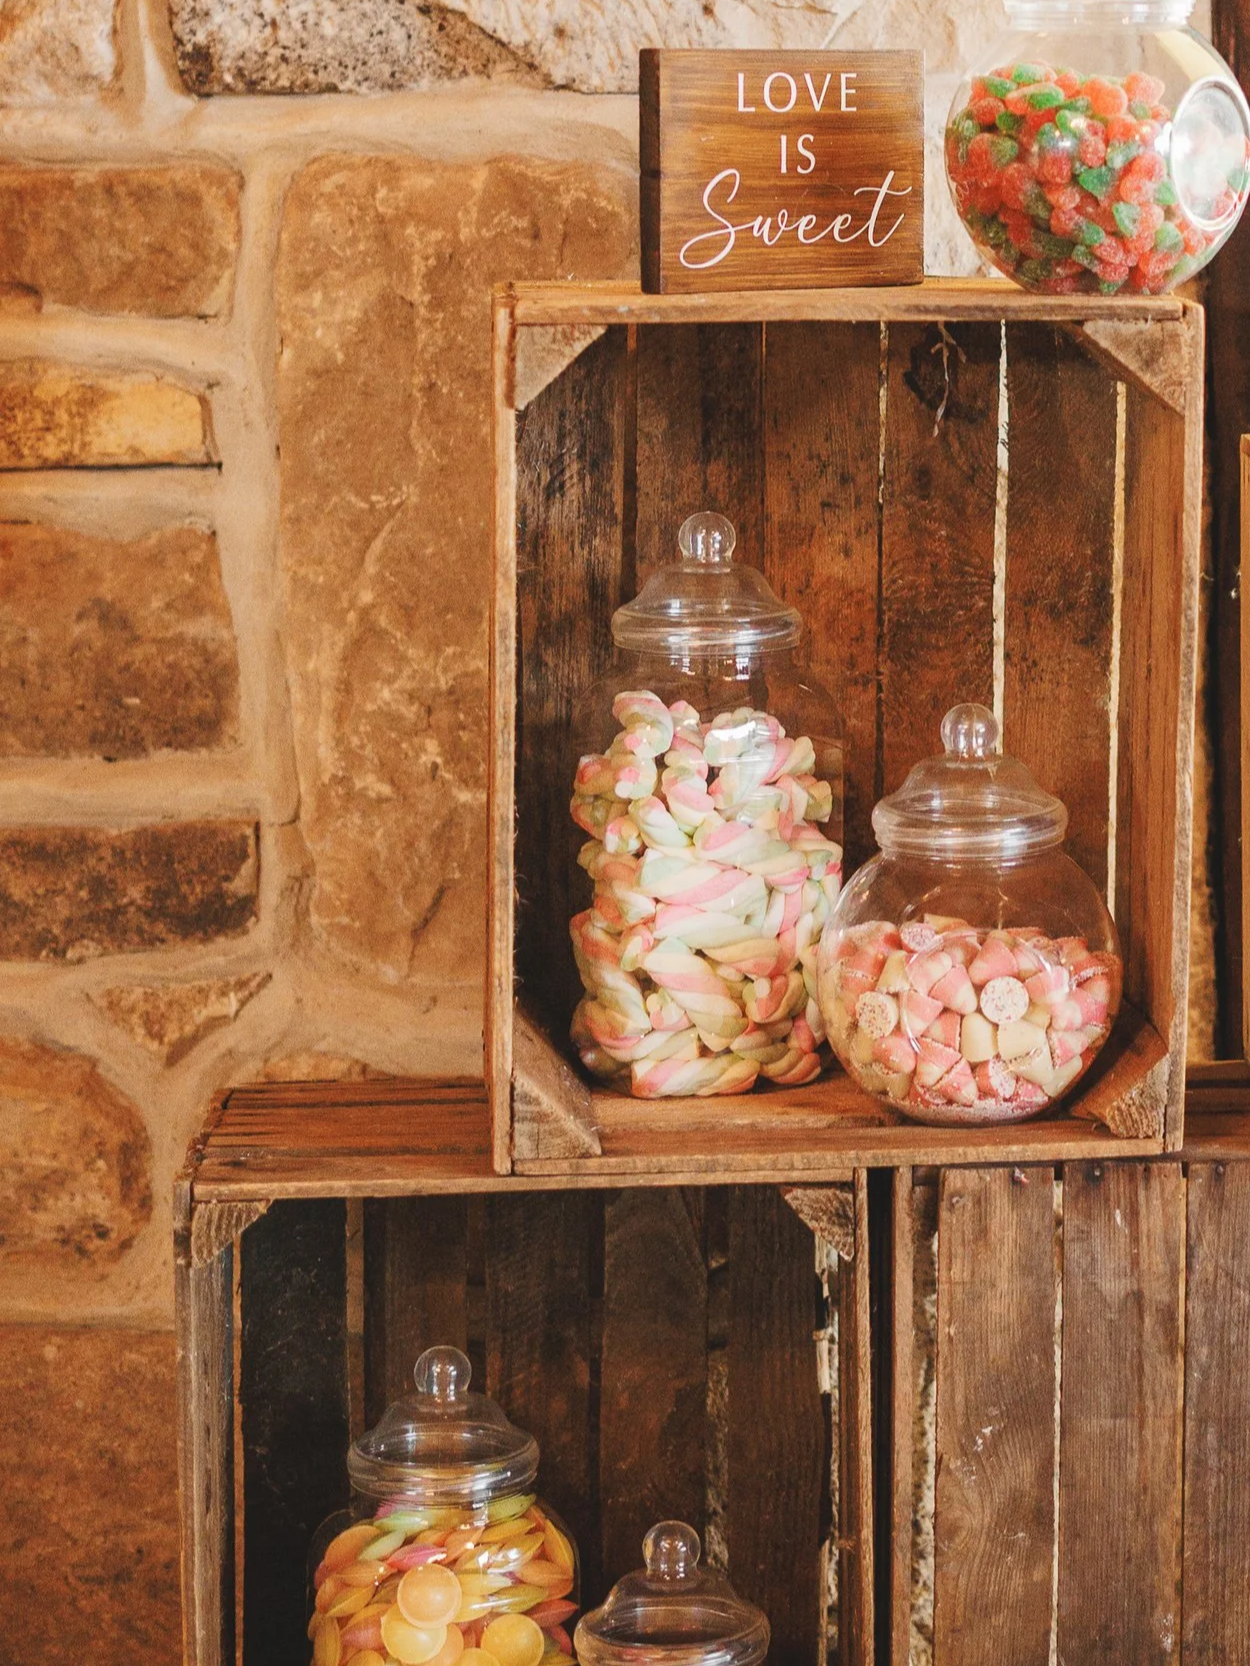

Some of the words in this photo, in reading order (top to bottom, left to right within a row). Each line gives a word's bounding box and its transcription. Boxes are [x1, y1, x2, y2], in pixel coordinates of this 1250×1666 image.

[737, 72, 857, 112] LOVE
[780, 134, 816, 174] IS
[679, 169, 912, 269] Sweet
